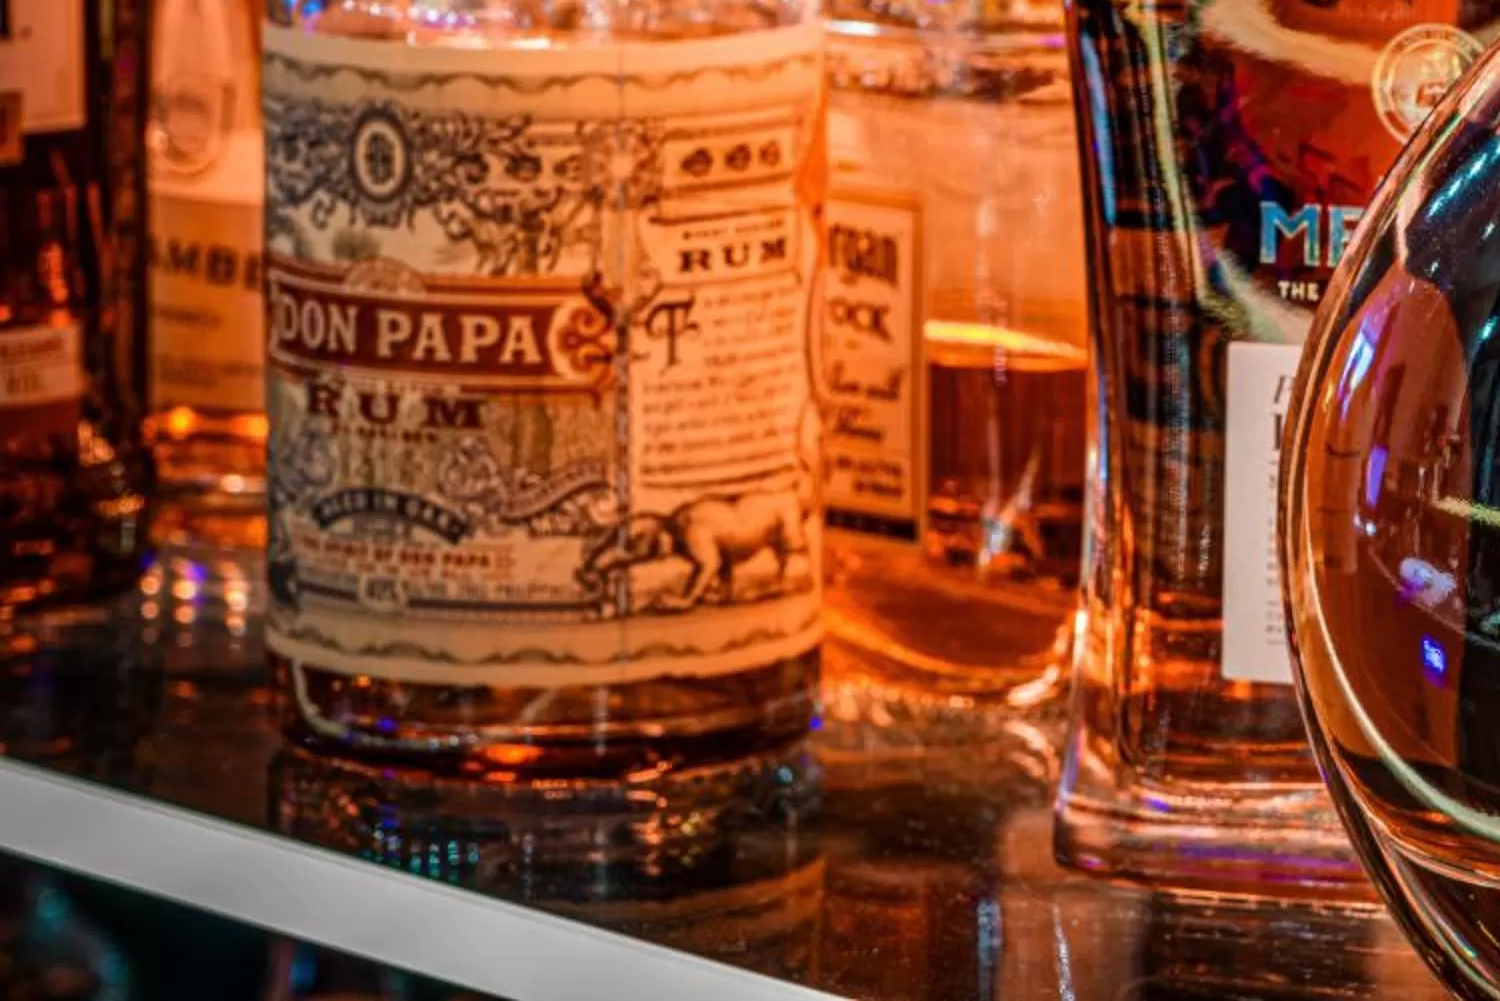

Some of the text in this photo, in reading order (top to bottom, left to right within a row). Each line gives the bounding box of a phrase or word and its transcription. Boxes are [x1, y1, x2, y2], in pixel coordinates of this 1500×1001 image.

[679, 237, 787, 273] RUM
[1277, 280, 1320, 302] THE
[277, 296, 358, 355] DON
[375, 309, 543, 365] PAPA
[307, 383, 488, 429] RUM
